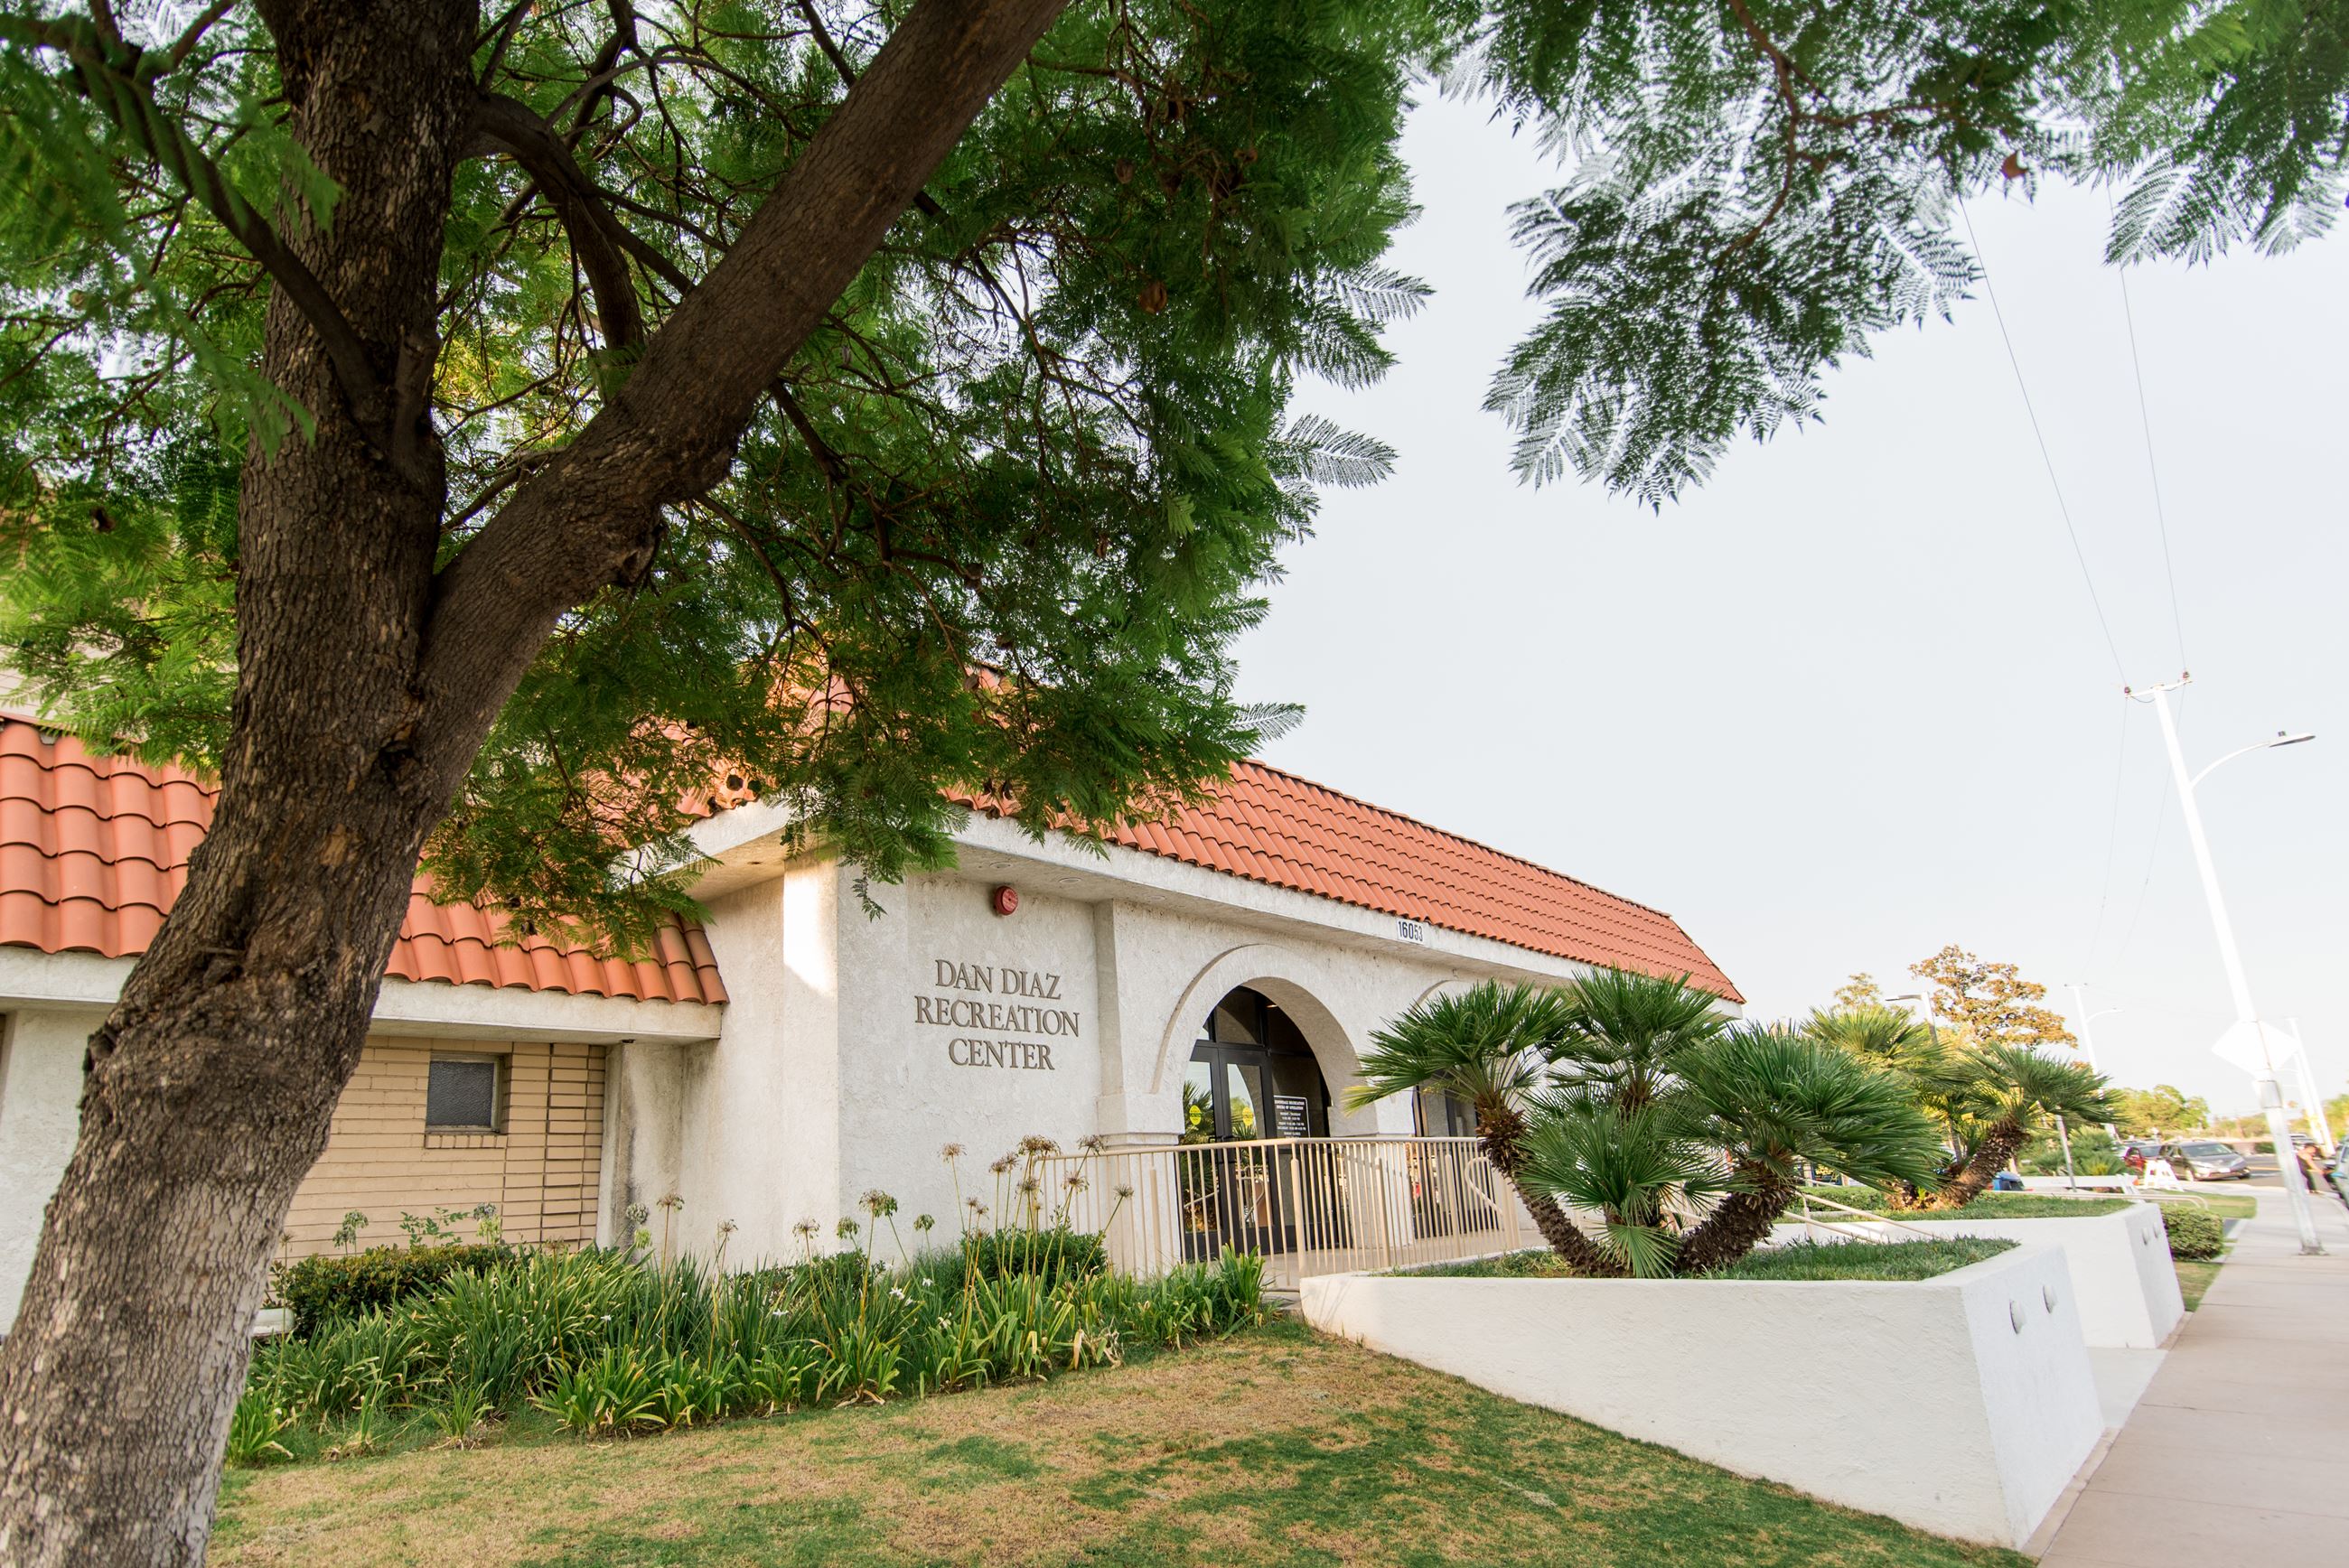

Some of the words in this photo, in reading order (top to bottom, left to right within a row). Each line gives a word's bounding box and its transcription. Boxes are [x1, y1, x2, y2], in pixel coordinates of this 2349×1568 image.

[1399, 921, 1423, 941] 16053
[935, 959, 993, 994] DAN
[1001, 967, 1062, 1000] DIAZ
[914, 995, 1080, 1037] RECREATION
[949, 1038, 1055, 1070] CENTER
